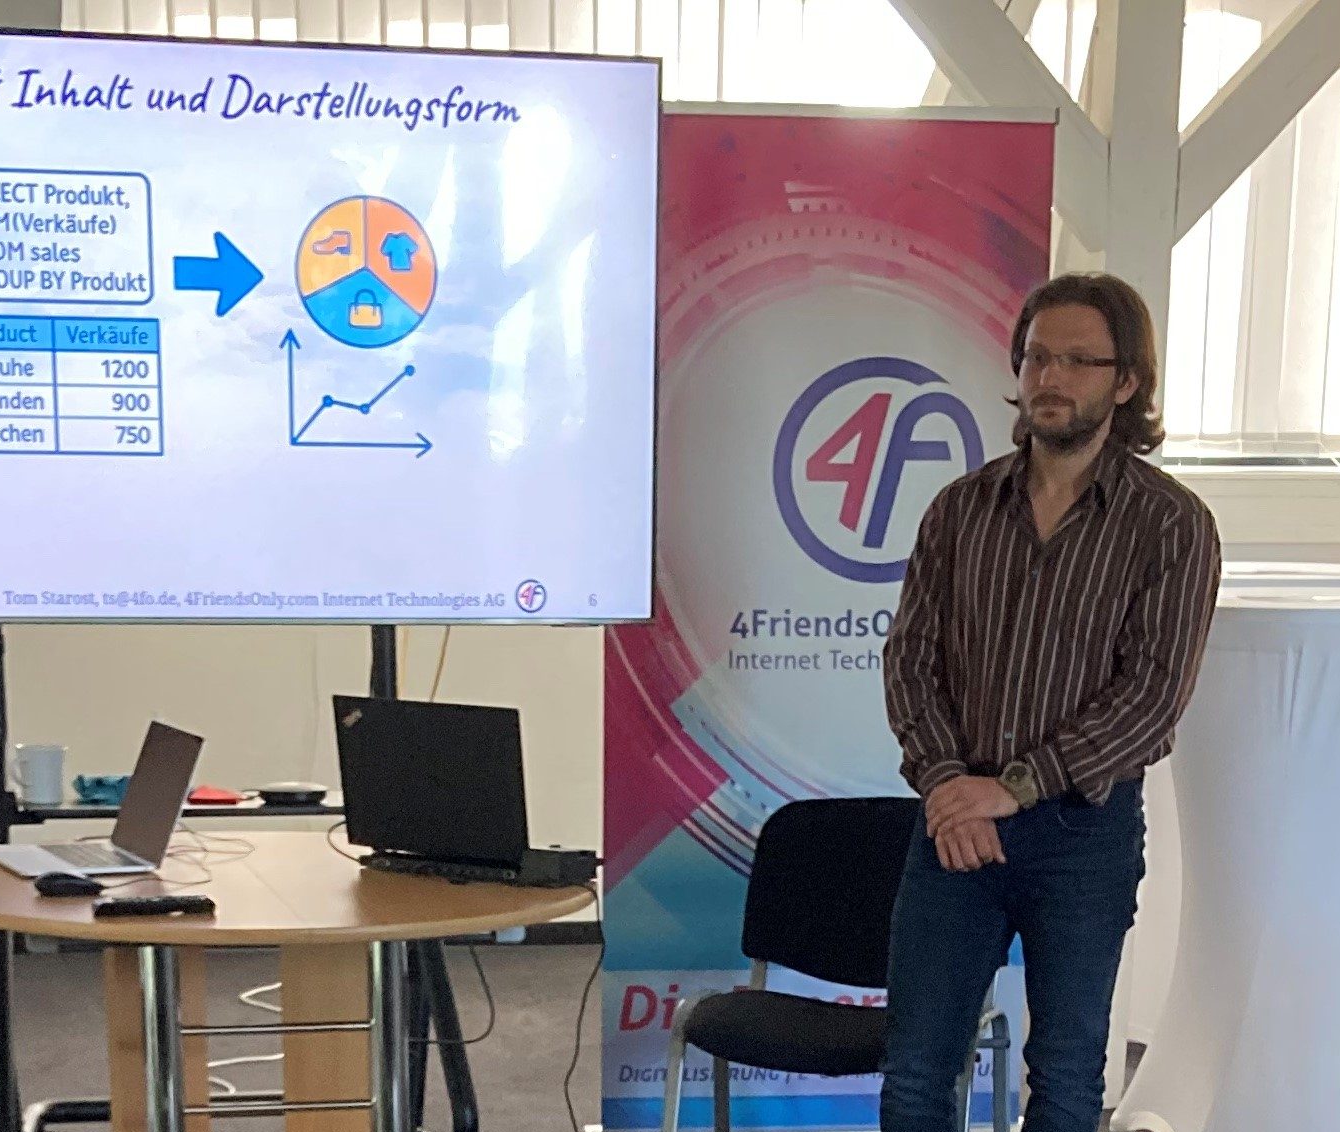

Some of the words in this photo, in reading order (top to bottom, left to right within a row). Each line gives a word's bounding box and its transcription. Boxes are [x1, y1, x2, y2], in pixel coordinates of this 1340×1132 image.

[11, 68, 134, 111] Inhalt
[147, 77, 215, 113] und
[220, 74, 521, 131] Darstellungsform
[44, 184, 130, 210] Produkt,
[30, 242, 81, 263] sales
[40, 271, 65, 290] BY
[71, 271, 146, 292] Produkt
[66, 325, 149, 345] Verkäufe
[101, 360, 149, 378] 1200
[112, 393, 150, 411] 900
[115, 426, 151, 444] 750
[3, 591, 37, 605] Tom
[185, 591, 319, 609] 4FriendsOnly.com
[323, 592, 383, 606] Internet
[386, 592, 480, 610] Technologies
[484, 593, 505, 607] AG
[588, 593, 598, 607] 6
[730, 608, 895, 638] 4FriendsO
[728, 649, 821, 671] Internet
[829, 649, 881, 671] Tech
